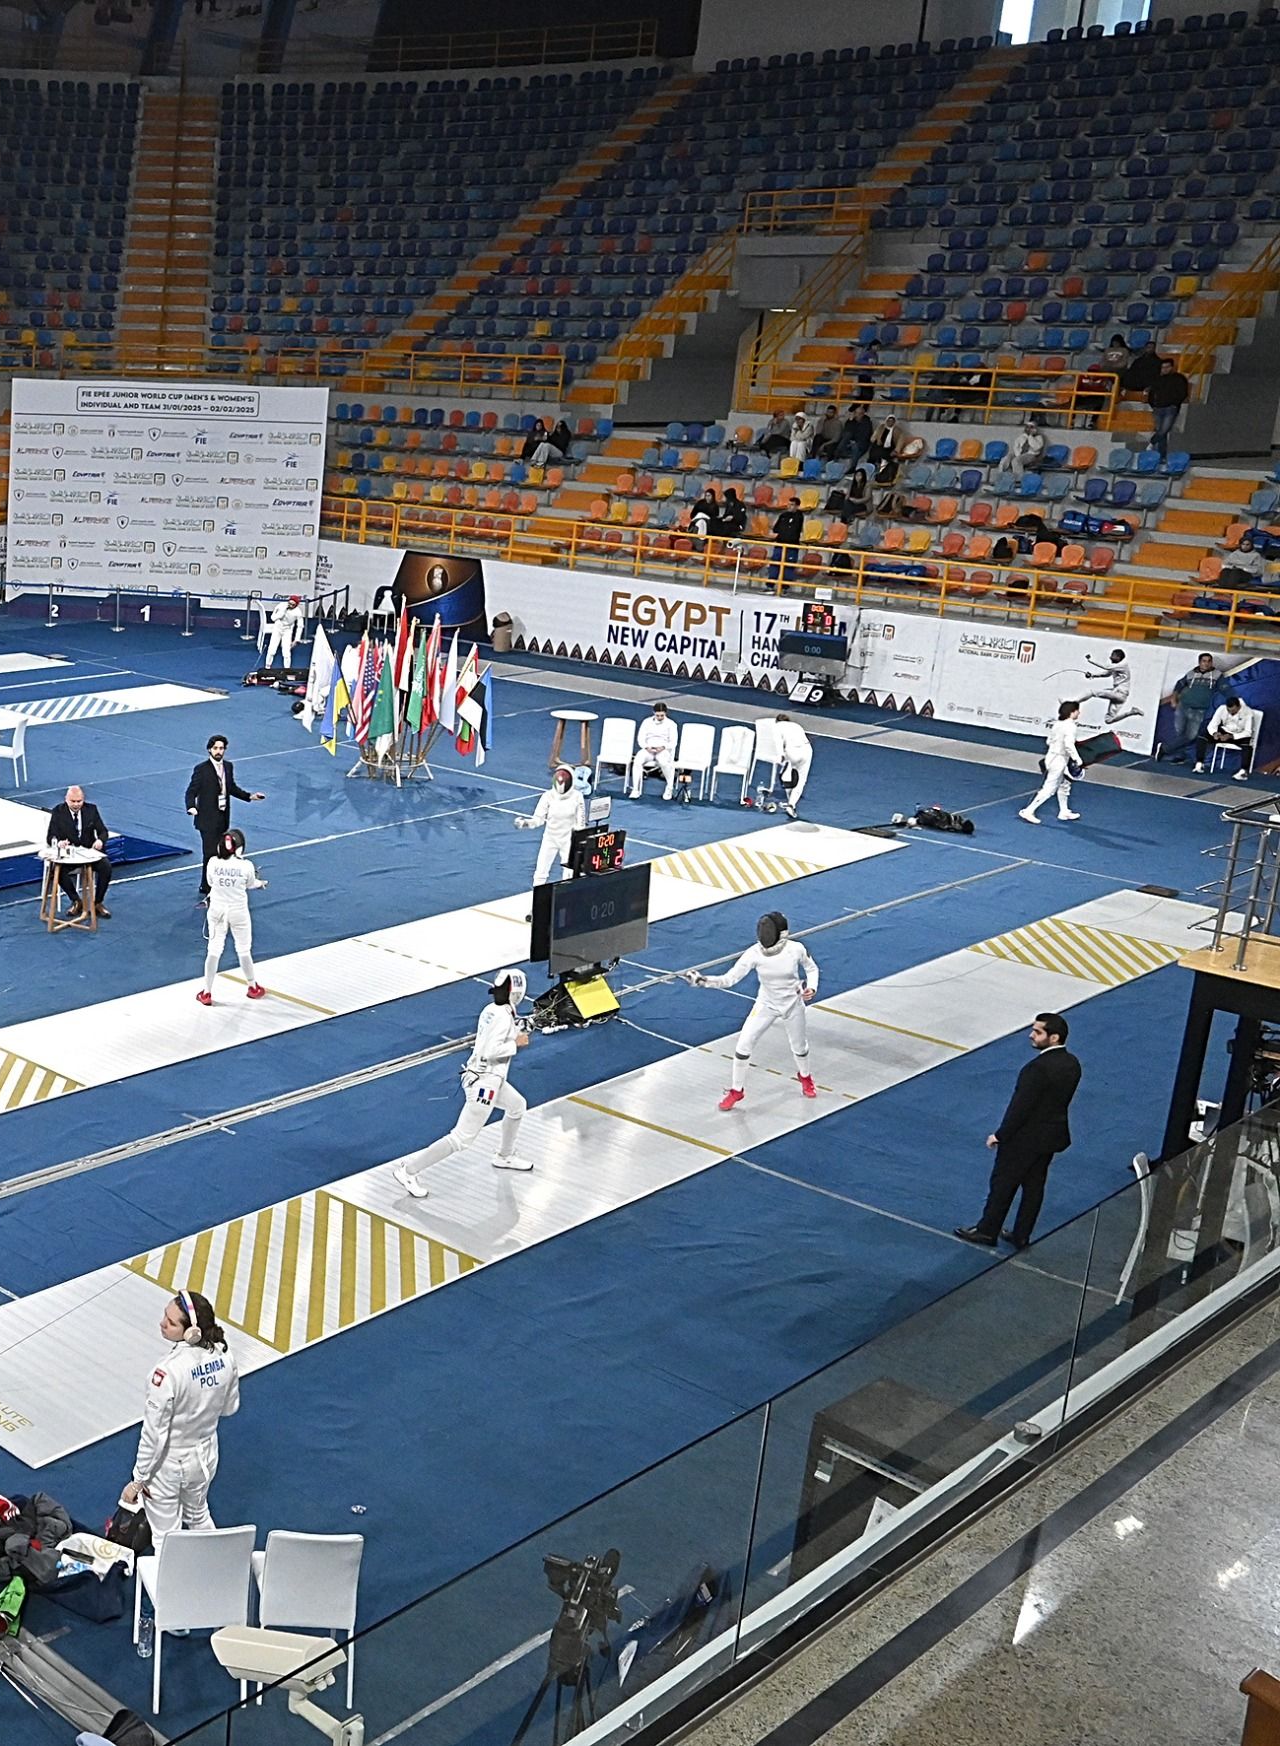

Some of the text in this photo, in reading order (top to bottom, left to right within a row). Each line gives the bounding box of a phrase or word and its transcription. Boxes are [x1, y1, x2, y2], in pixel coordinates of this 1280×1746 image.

[112, 391, 139, 399] JUNIOR
[140, 392, 167, 400] WORLD
[80, 401, 122, 409] INDIVIDUAL
[209, 405, 255, 413] 02/02/2025
[51, 604, 59, 617] 2
[140, 605, 151, 622] 1
[608, 590, 731, 637] EGYPT
[233, 619, 241, 628] 3
[808, 614, 814, 624] 3
[825, 615, 832, 626] 0
[607, 624, 649, 649] NEW
[1000, 653, 1015, 661] EGYPT
[809, 689, 824, 702] 9
[598, 834, 615, 848] 0:20
[592, 849, 624, 869] 4 2
[219, 878, 237, 887] EGY
[590, 900, 615, 921] 0:20
[476, 1097, 491, 1106] FRA
[200, 1375, 219, 1388] POL
